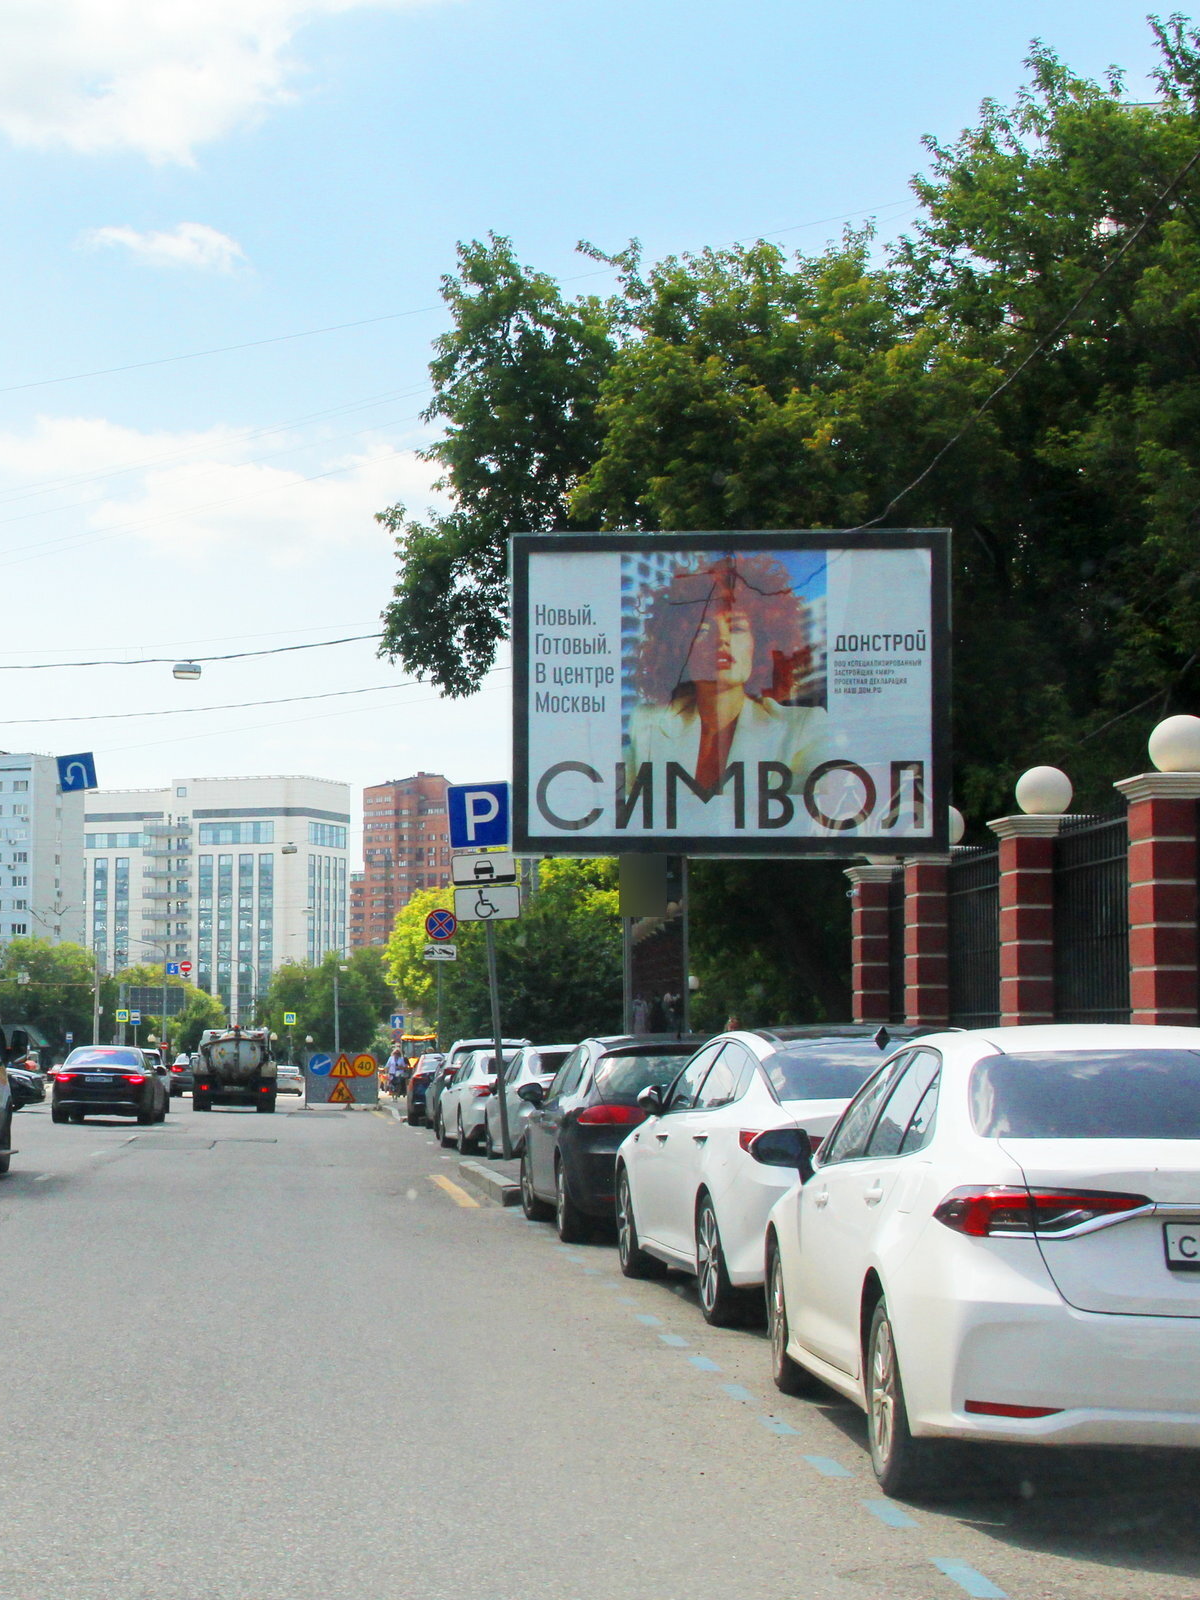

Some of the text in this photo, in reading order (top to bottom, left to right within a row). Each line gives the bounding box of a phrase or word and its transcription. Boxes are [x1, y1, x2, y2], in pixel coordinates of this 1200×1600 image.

[535, 604, 596, 626] Новый.
[535, 633, 611, 655] Готовый.
[834, 630, 926, 652] ДОНСТРОЙ
[535, 662, 614, 688] В центре
[535, 691, 605, 713] Москвы
[536, 759, 925, 830] СИМВОЛ
[464, 791, 499, 841] P
[358, 1061, 372, 1071] 40
